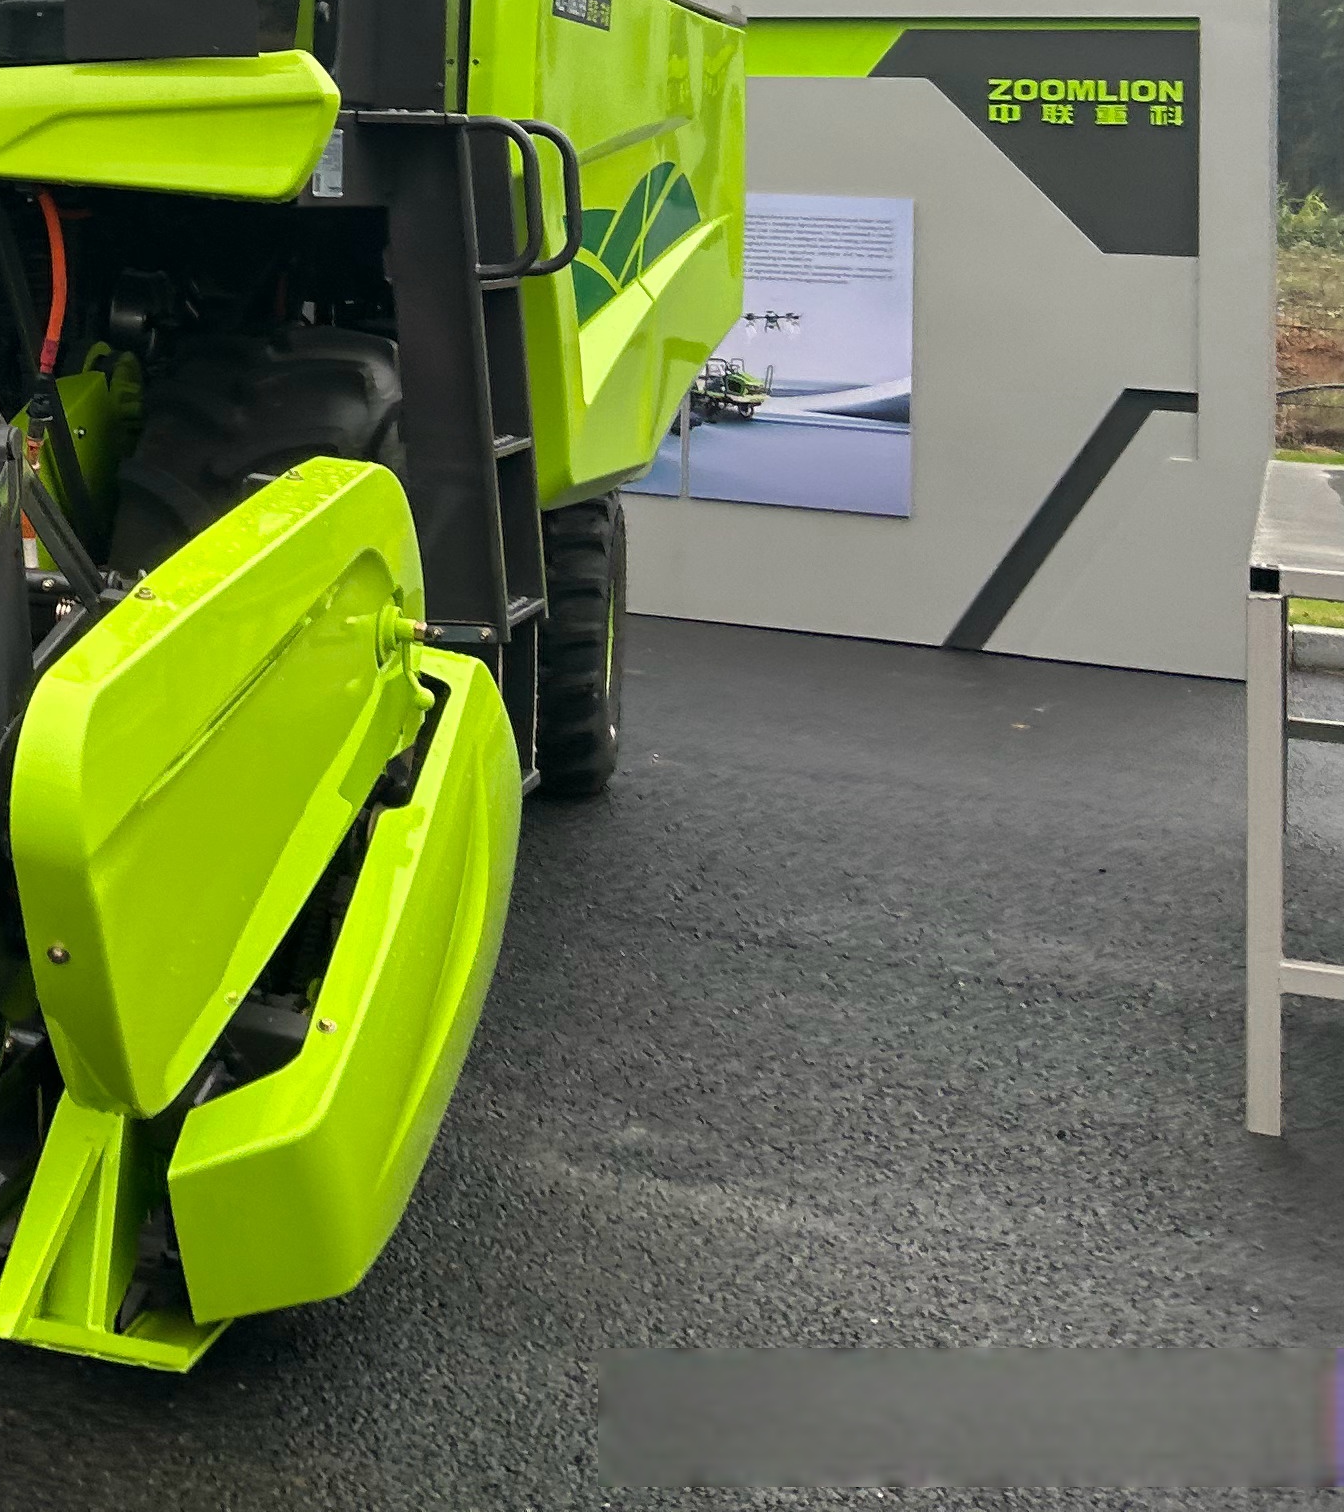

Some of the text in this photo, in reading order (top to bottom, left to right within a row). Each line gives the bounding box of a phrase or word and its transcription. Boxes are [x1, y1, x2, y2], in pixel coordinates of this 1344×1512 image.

[987, 78, 1184, 102] ZOOMLION
[988, 104, 1184, 126] 中联重科
